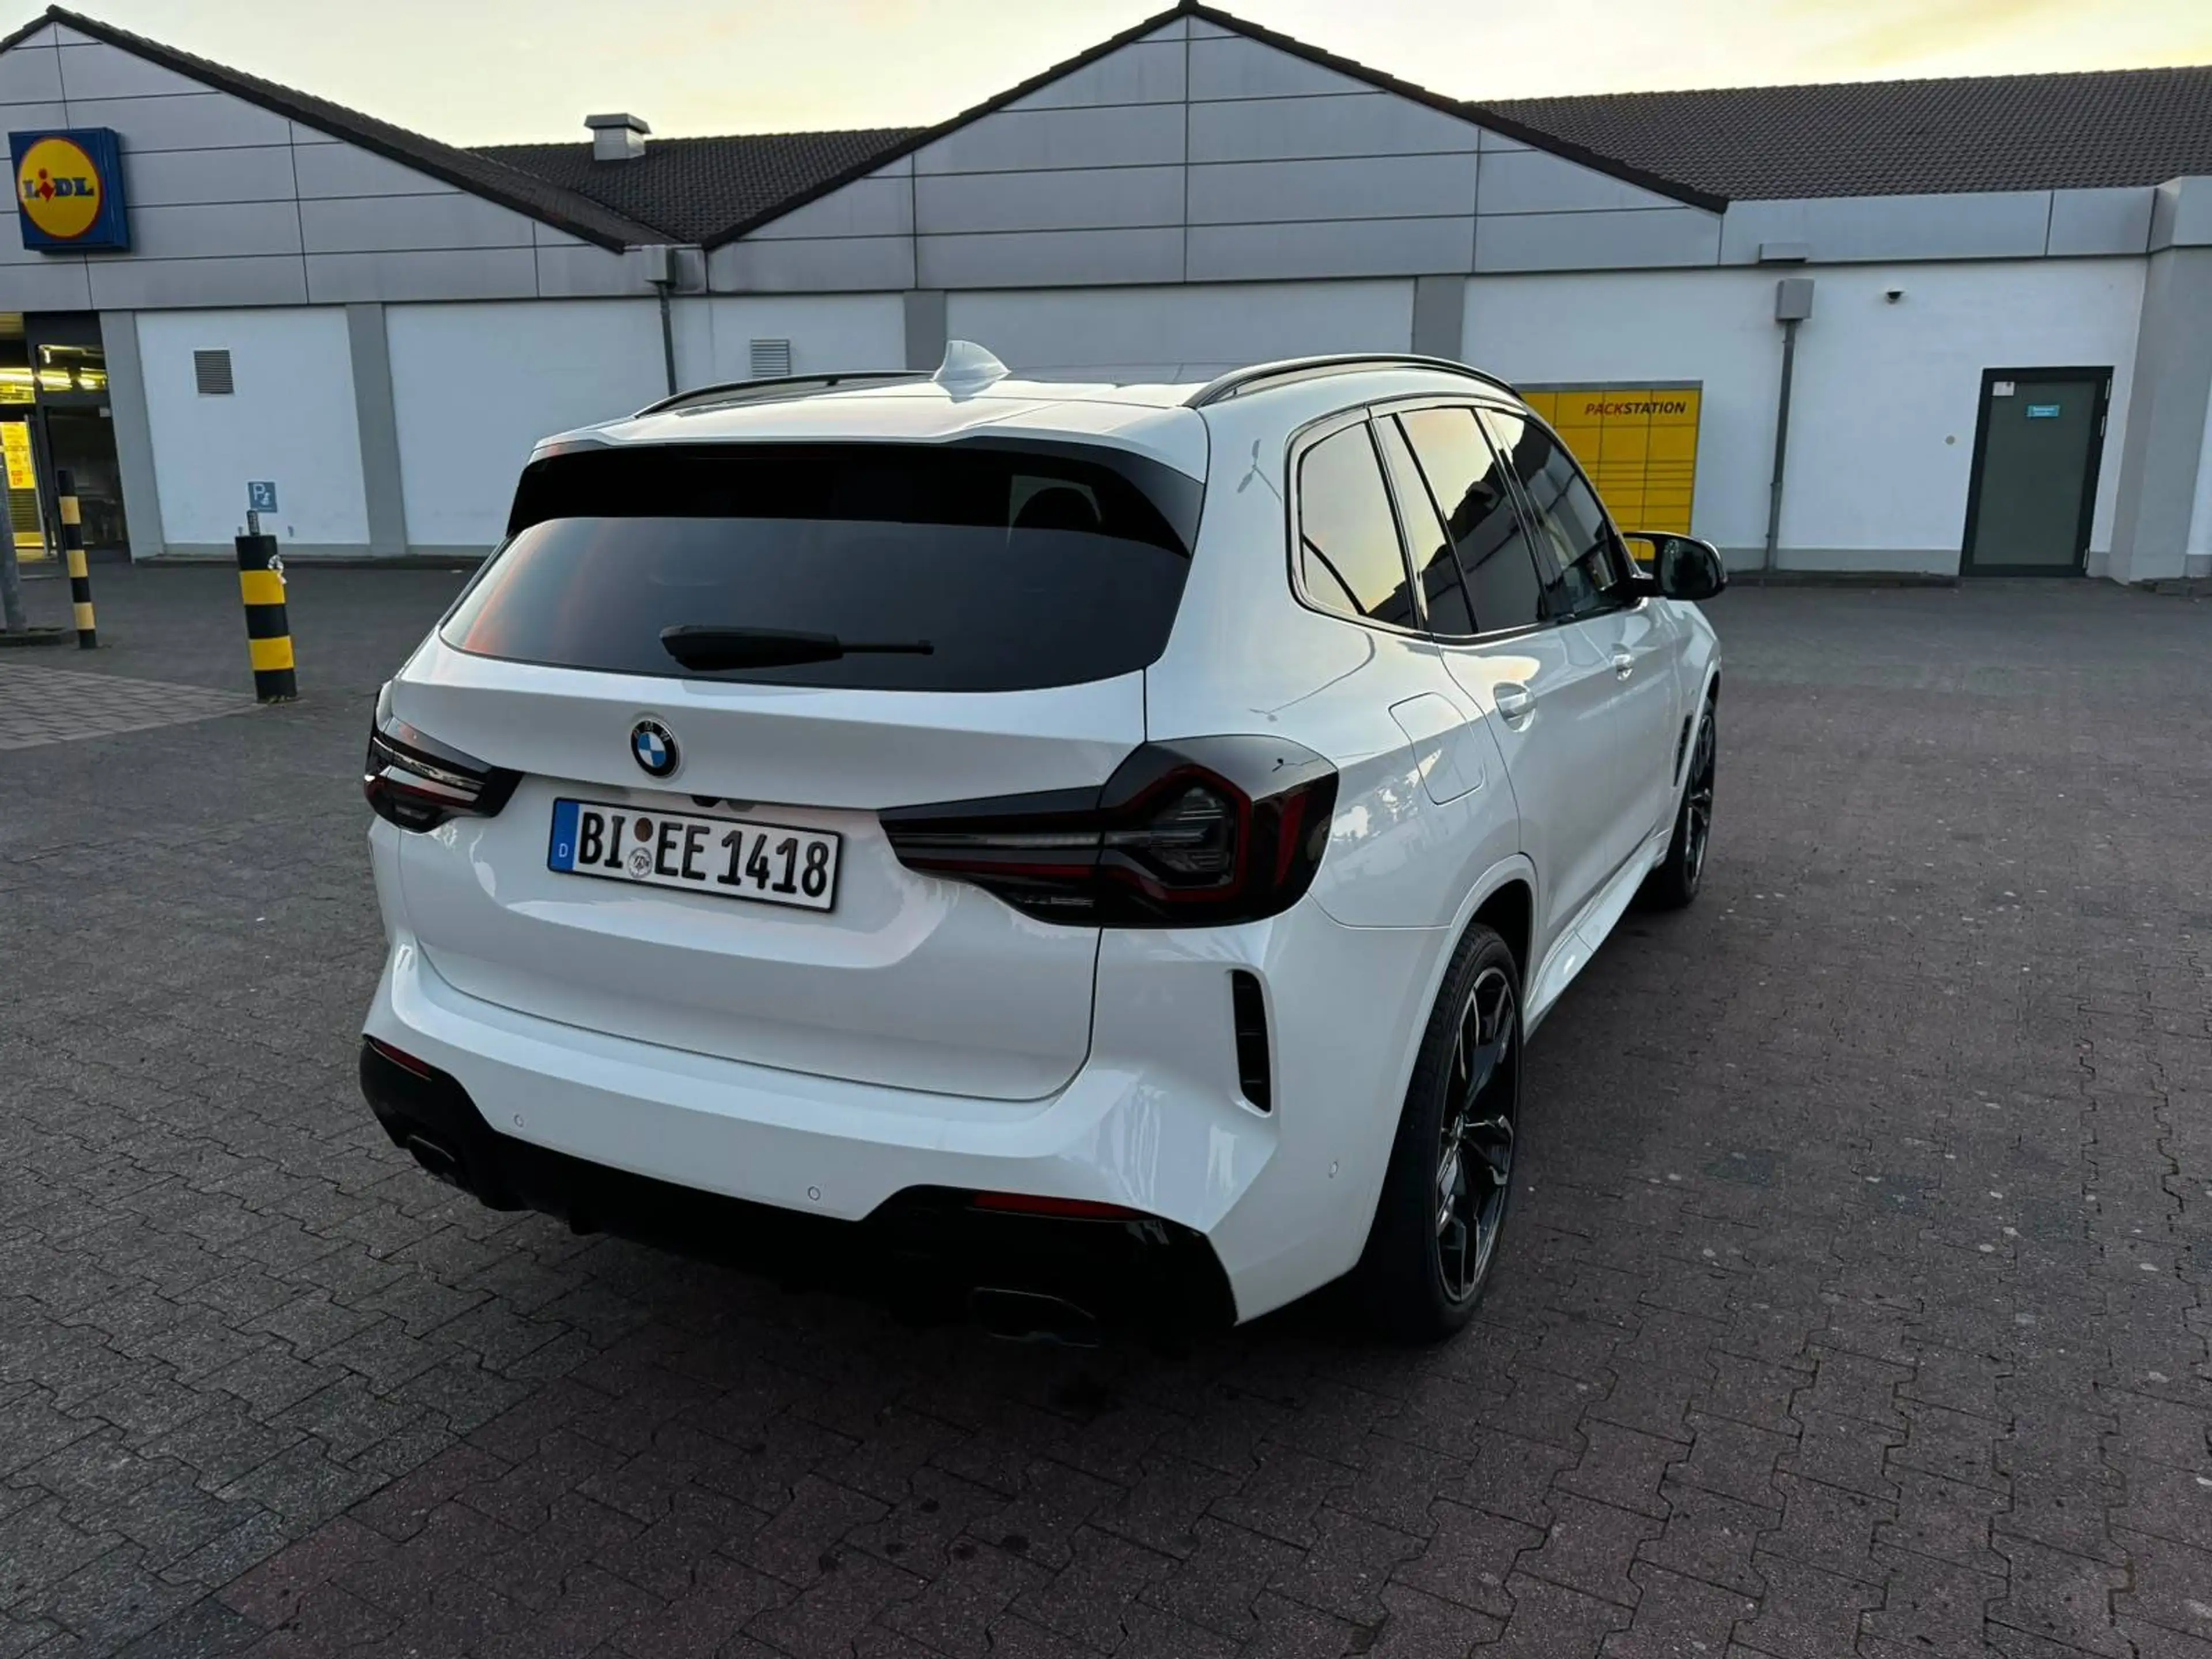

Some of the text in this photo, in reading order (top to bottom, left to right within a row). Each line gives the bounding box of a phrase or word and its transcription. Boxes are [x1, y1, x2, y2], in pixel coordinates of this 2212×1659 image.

[1585, 402, 1685, 415] PACKSTATION
[253, 484, 266, 501] P
[559, 848, 567, 858] D
[578, 812, 626, 869] BI
[654, 821, 710, 880] EE
[717, 830, 829, 897] 1418
